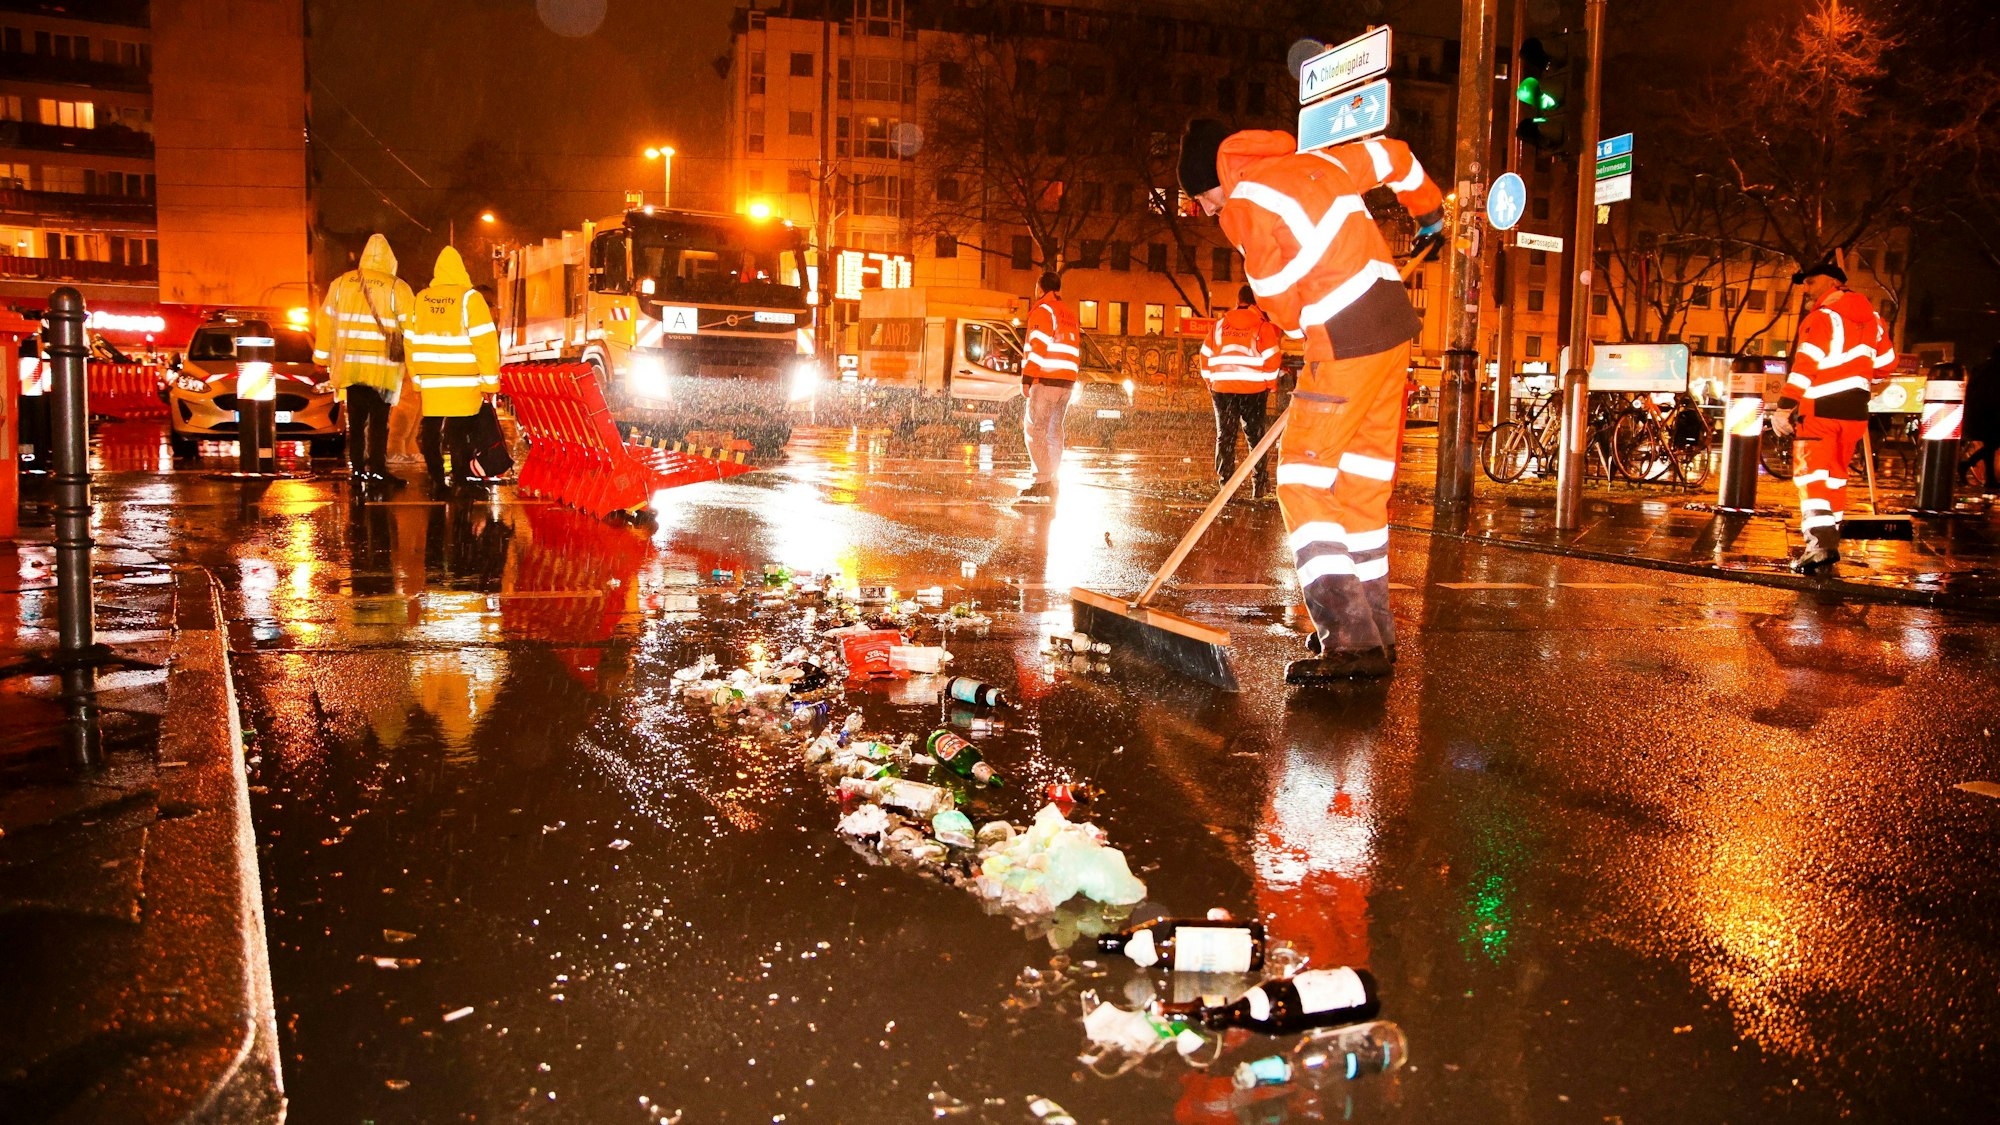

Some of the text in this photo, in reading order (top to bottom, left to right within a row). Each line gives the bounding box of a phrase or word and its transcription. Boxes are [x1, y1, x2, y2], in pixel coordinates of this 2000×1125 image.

[1320, 51, 1370, 82] Chlodwigplatz
[1596, 162, 1627, 175] oelnmesse
[349, 277, 385, 287] Seurity
[424, 294, 456, 305] Security
[673, 312, 687, 329] A
[883, 323, 911, 346] AWB
